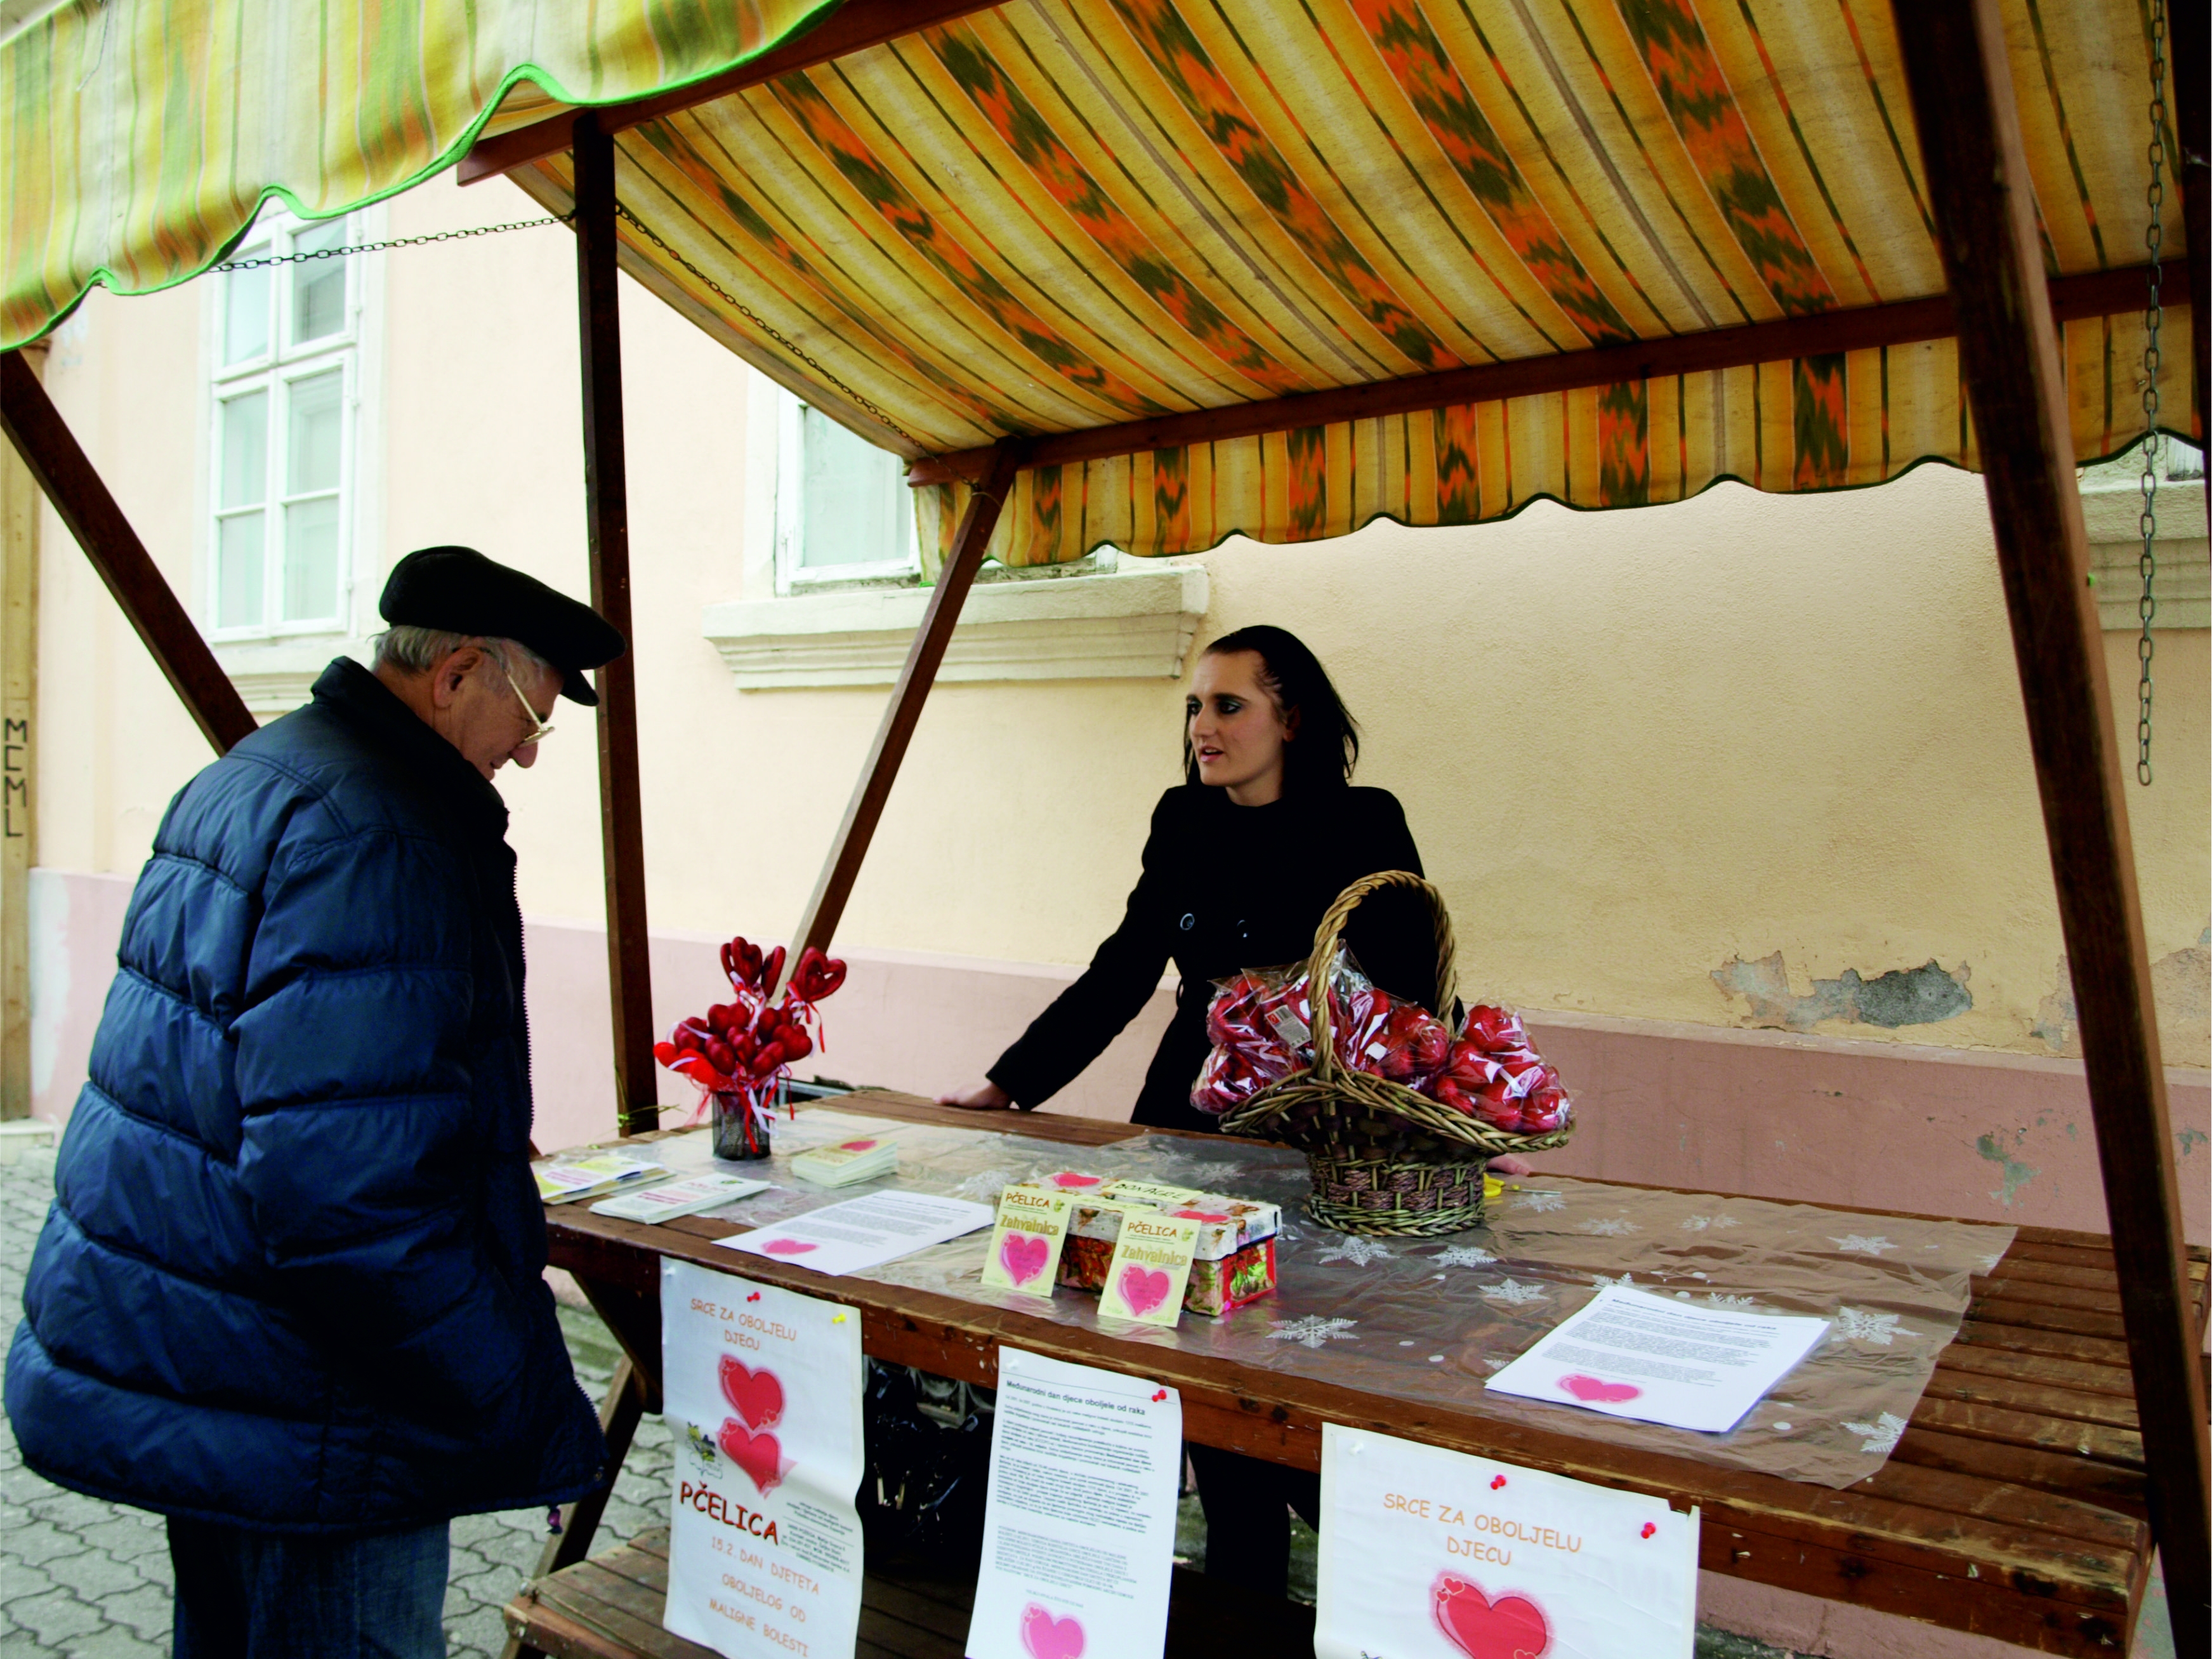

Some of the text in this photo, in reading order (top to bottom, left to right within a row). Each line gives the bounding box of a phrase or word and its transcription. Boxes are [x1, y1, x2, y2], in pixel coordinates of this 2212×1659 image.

[1006, 1192, 1050, 1208] PČELICA
[1000, 1214, 1059, 1236] Zahvalnica
[1127, 1220, 1177, 1238] PČELICA
[1121, 1245, 1187, 1266] Zahvalnica
[691, 1298, 797, 1342] SRCE ZA OBOLJELU
[725, 1329, 760, 1351] DJECU
[1048, 1391, 1061, 1400] dan
[1062, 1394, 1083, 1405] djece
[1085, 1398, 1116, 1411] oboljele
[1117, 1405, 1127, 1413] od
[1129, 1406, 1146, 1416] raka
[680, 1479, 778, 1546] PČELICA
[1383, 1493, 1582, 1553] SRCE ZA OBOLJELU
[1447, 1535, 1511, 1566] DJECU
[740, 1549, 763, 1569] DAN
[771, 1562, 820, 1595] DJETETA
[722, 1573, 806, 1623] OBOLJELOG OD
[709, 1598, 809, 1658] MALIGNE BOLESTI
